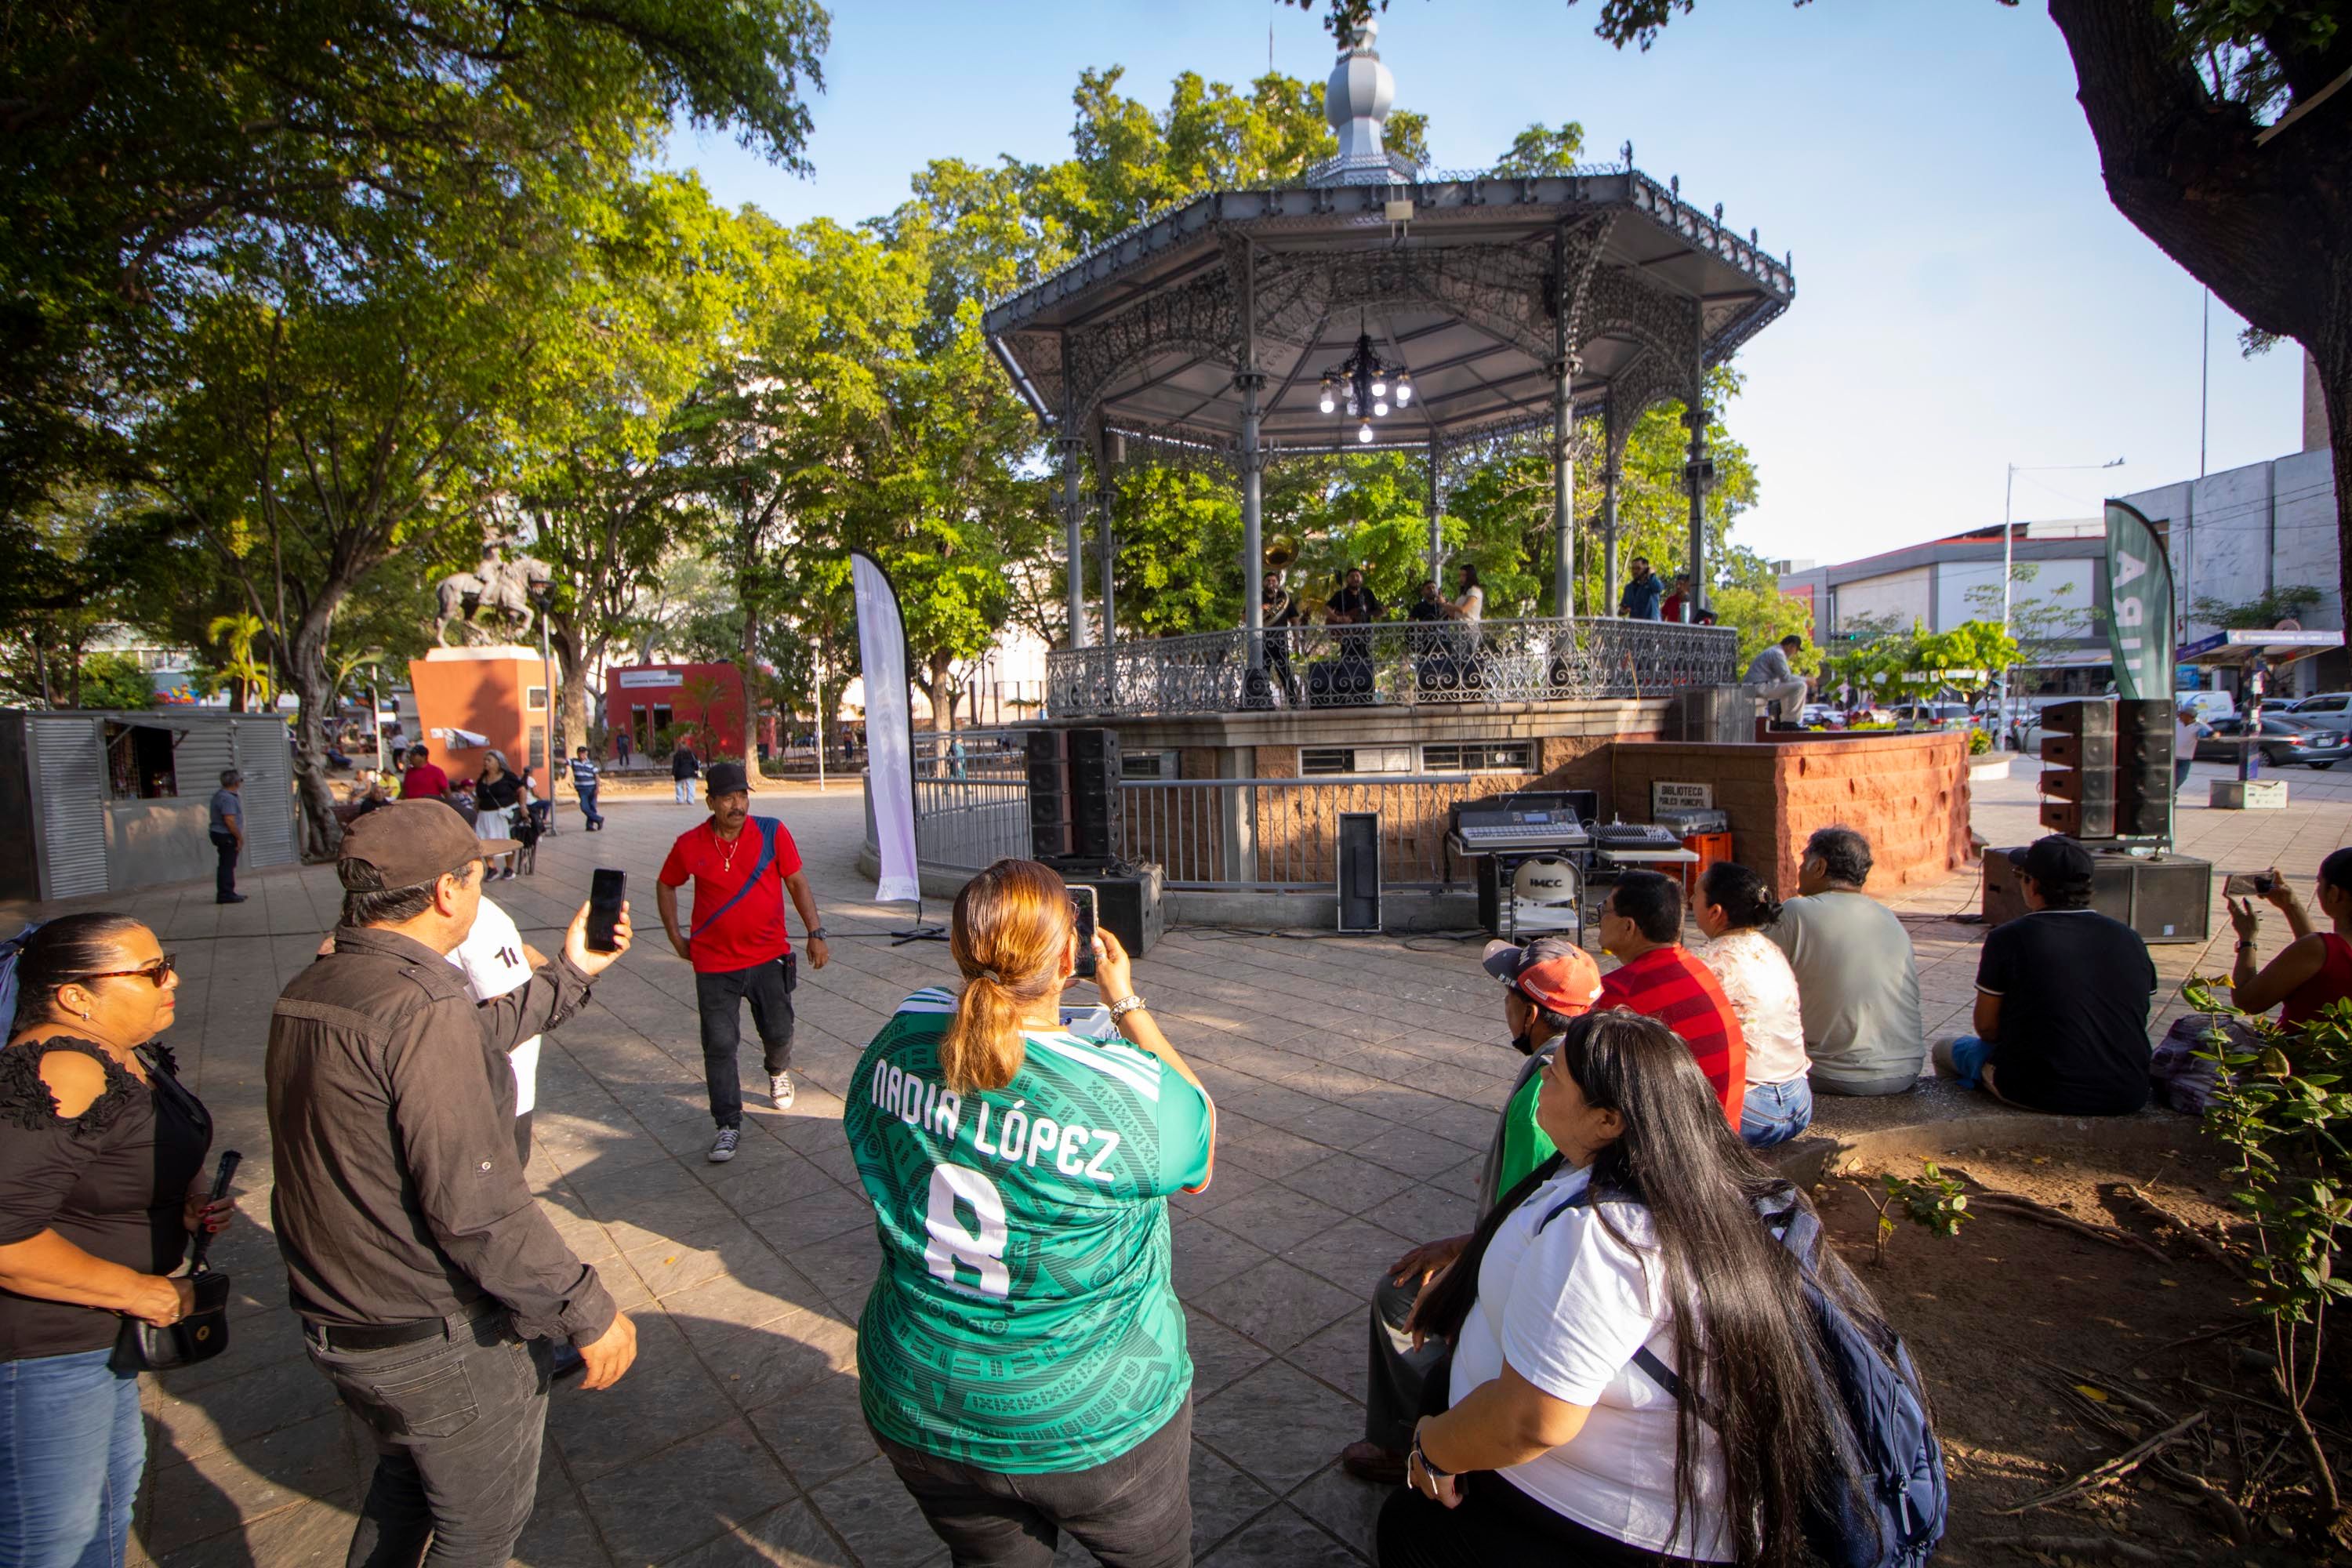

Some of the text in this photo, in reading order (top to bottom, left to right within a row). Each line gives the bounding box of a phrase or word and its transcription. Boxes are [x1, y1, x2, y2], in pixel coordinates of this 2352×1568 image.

[1661, 786, 1703, 797] BIBLIOTECA
[1530, 878, 1563, 887] IMCC
[872, 1058, 1120, 1182] NADIA LÓPEZ
